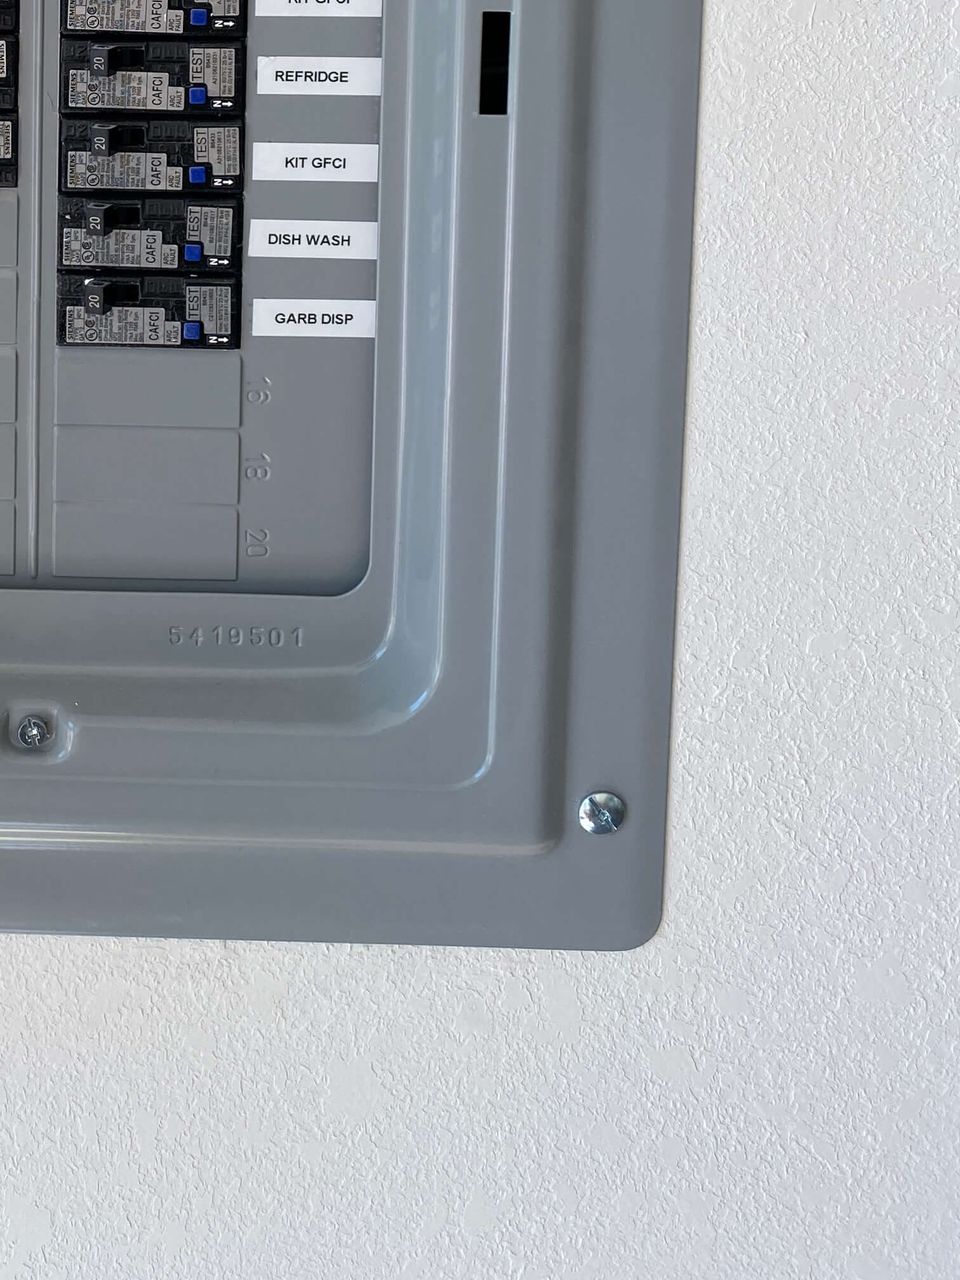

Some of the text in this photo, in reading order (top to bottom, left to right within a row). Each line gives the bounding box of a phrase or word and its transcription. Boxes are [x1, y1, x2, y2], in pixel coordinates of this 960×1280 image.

[152, 0, 162, 30] CAFCI
[94, 57, 104, 70] 20
[192, 50, 202, 81] TEST
[275, 71, 348, 83] REFRIDGE
[152, 77, 162, 106] CAFCI
[95, 137, 105, 150] 20
[196, 130, 207, 160] TEST
[151, 156, 161, 186] CAFCI
[285, 157, 346, 169] KIT GFCI
[90, 216, 101, 230] 20
[188, 208, 199, 239] TEST
[146, 234, 156, 264] CAFCI
[268, 234, 350, 246] DISH WASH
[89, 295, 99, 308] 20
[188, 288, 199, 318] TEST
[149, 311, 159, 341] CAFCI
[275, 313, 353, 325] GARB DISP
[245, 529, 269, 557] 20
